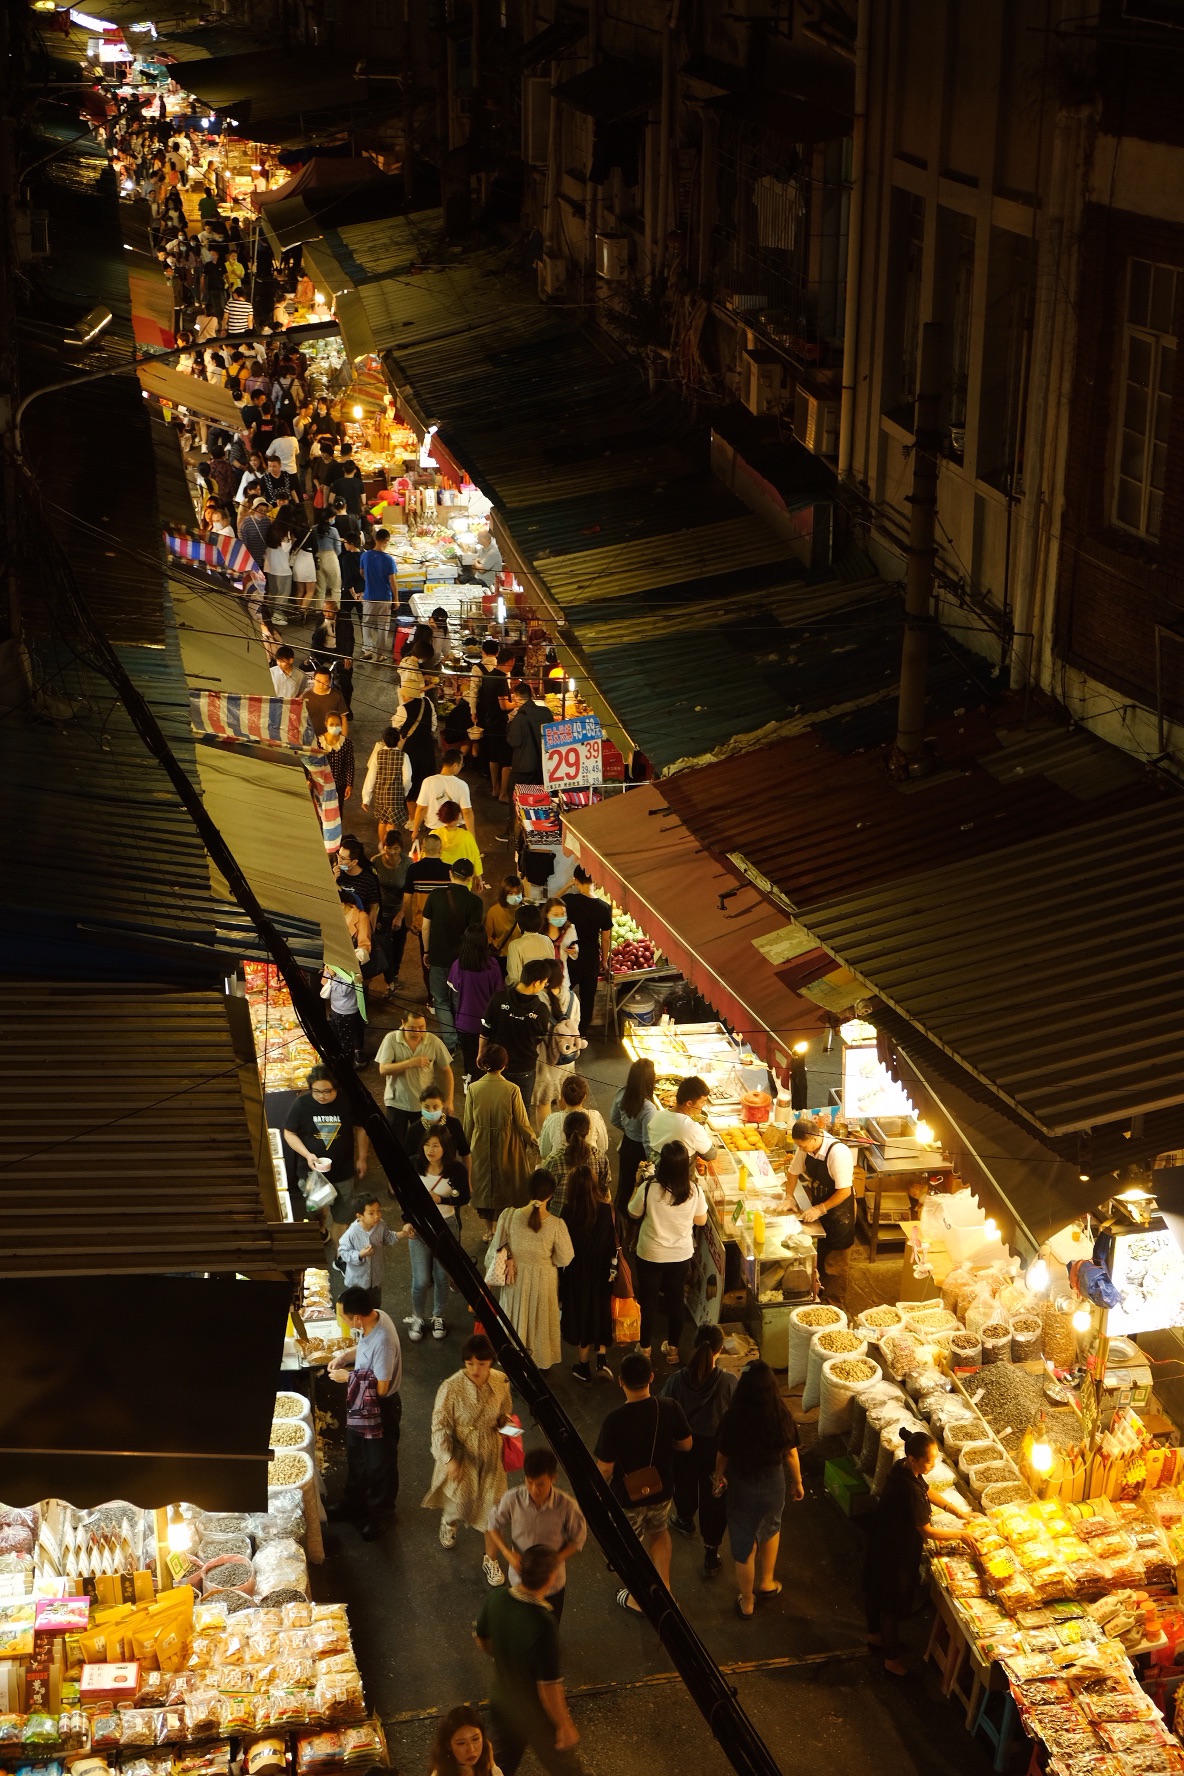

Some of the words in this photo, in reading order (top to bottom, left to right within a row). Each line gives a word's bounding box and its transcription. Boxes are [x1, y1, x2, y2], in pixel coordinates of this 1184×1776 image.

[548, 747, 580, 783] 29
[585, 740, 600, 760] 39
[312, 1115, 342, 1123] NATURAL
